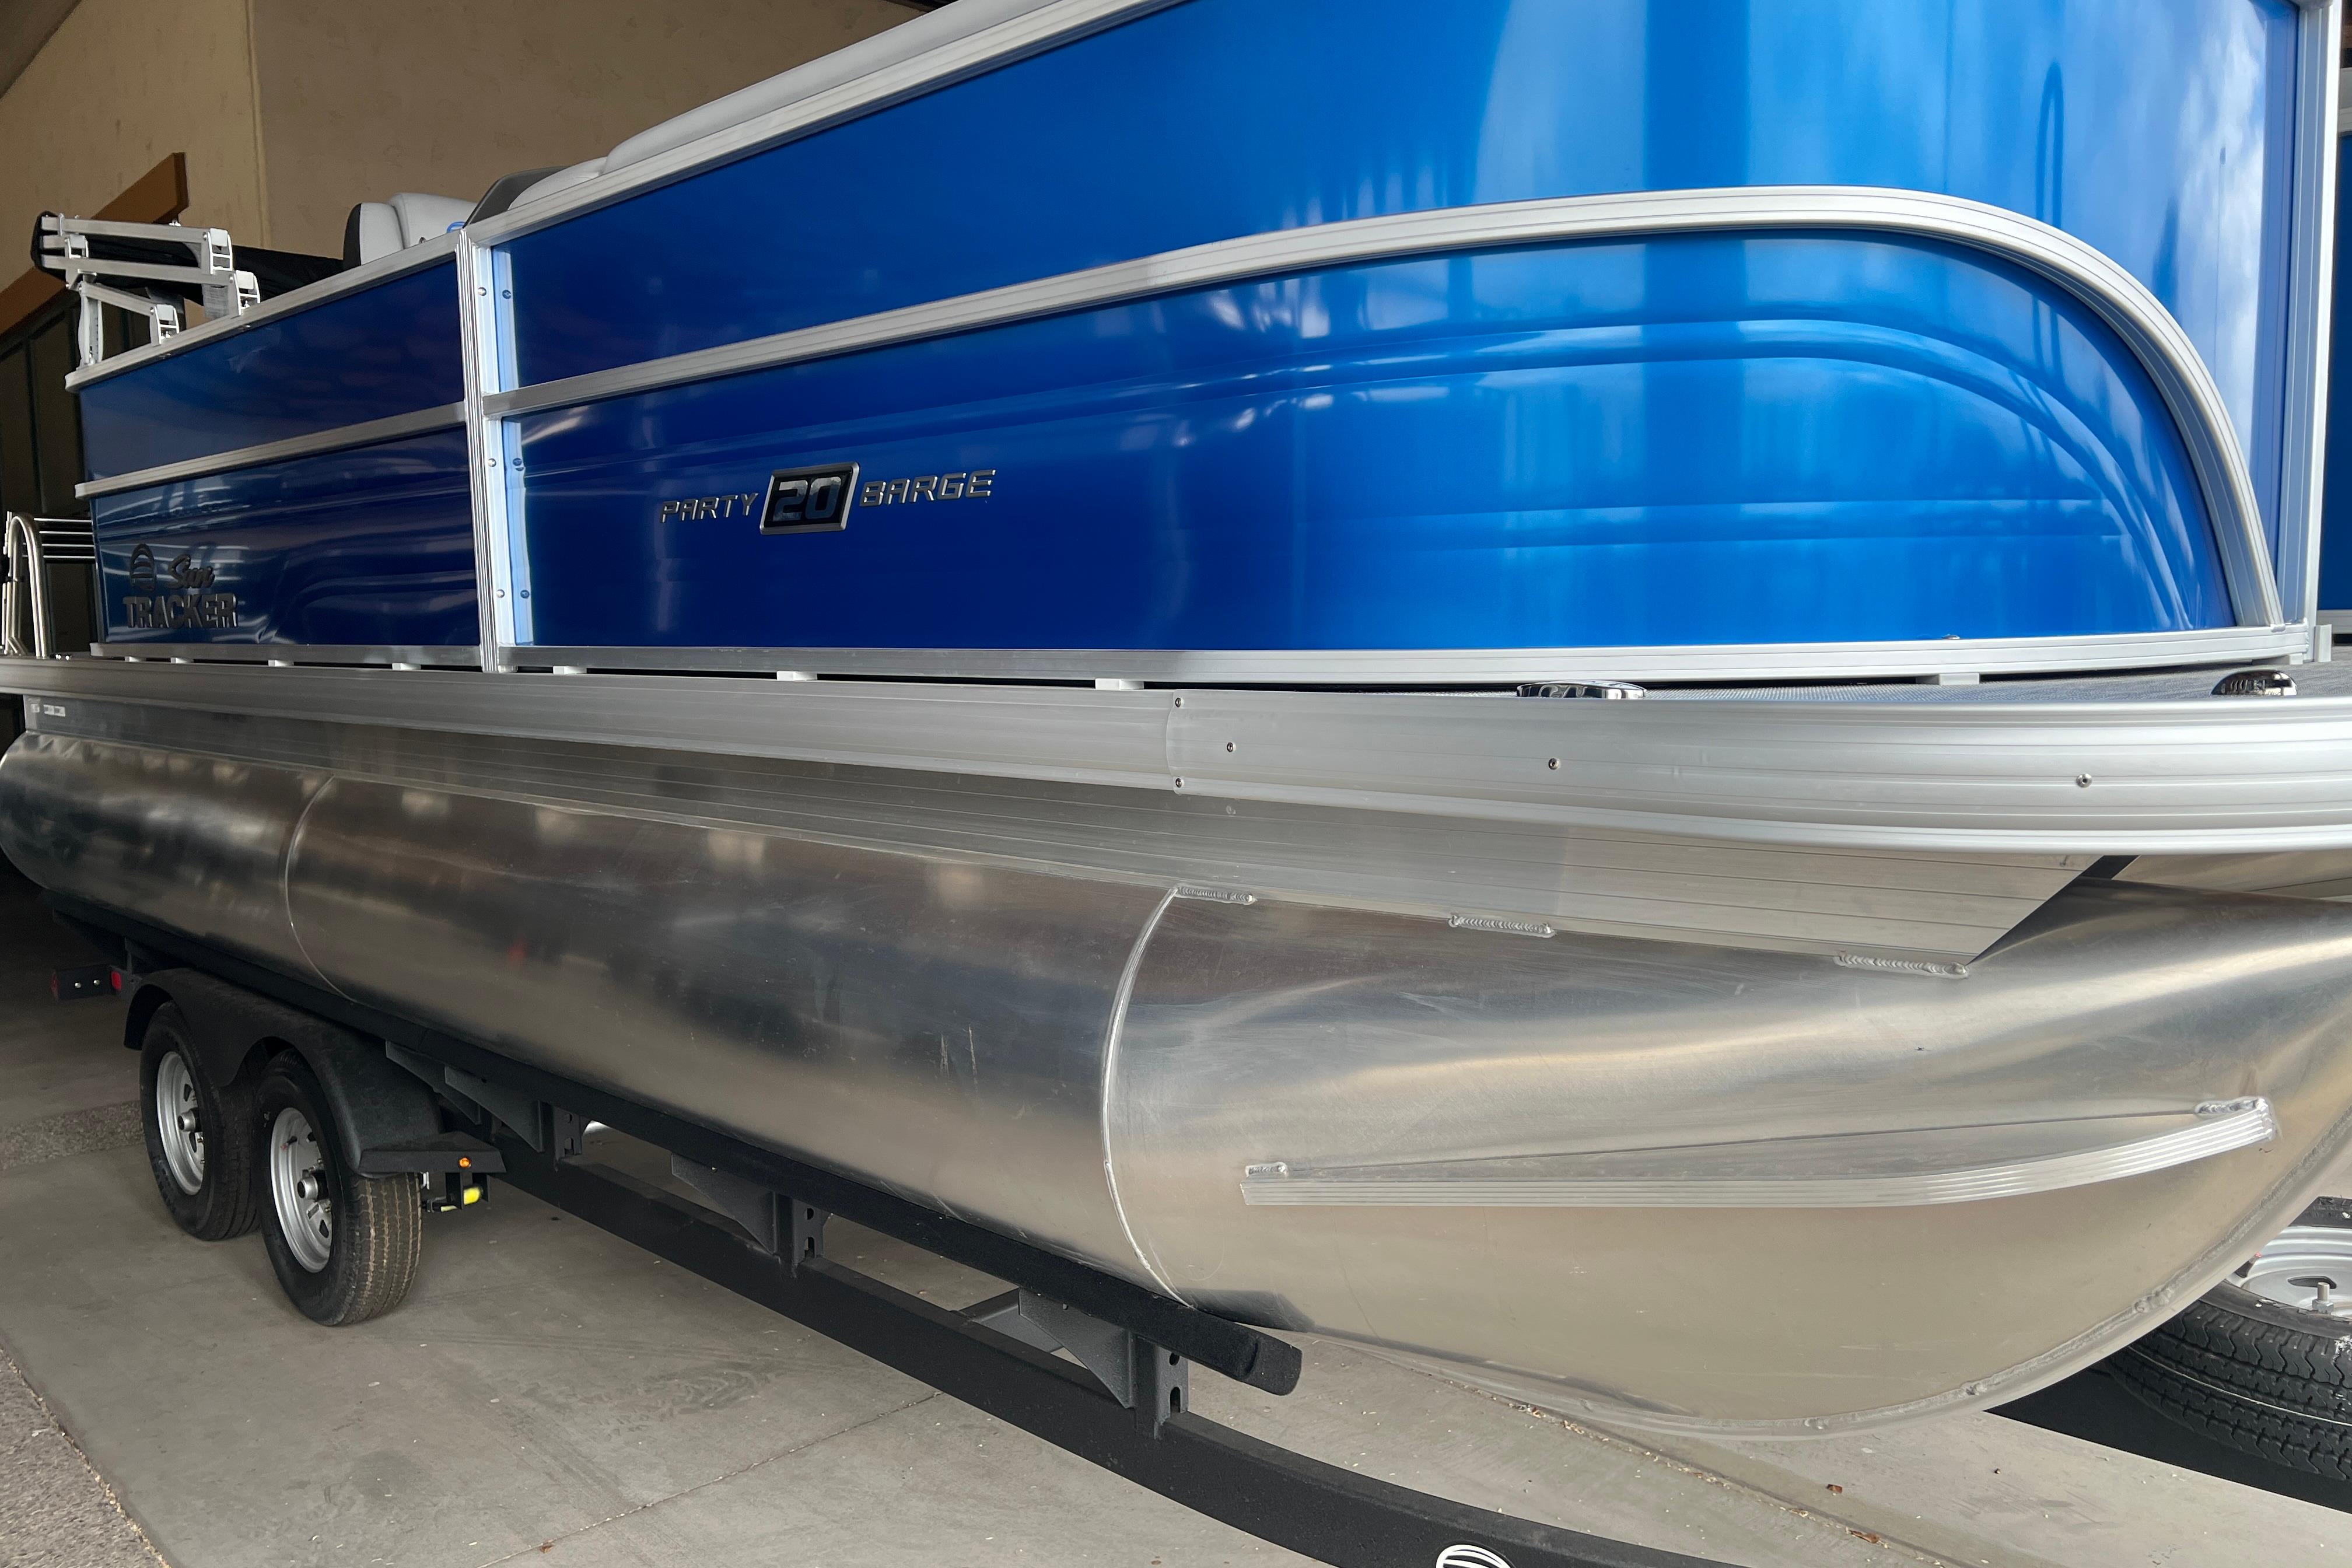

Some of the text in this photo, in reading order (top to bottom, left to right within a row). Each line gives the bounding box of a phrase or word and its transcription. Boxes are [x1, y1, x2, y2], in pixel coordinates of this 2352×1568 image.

[660, 469, 996, 523] PARTY 20 BARGE
[167, 554, 215, 589] Sun
[123, 593, 238, 628] TRACKER
